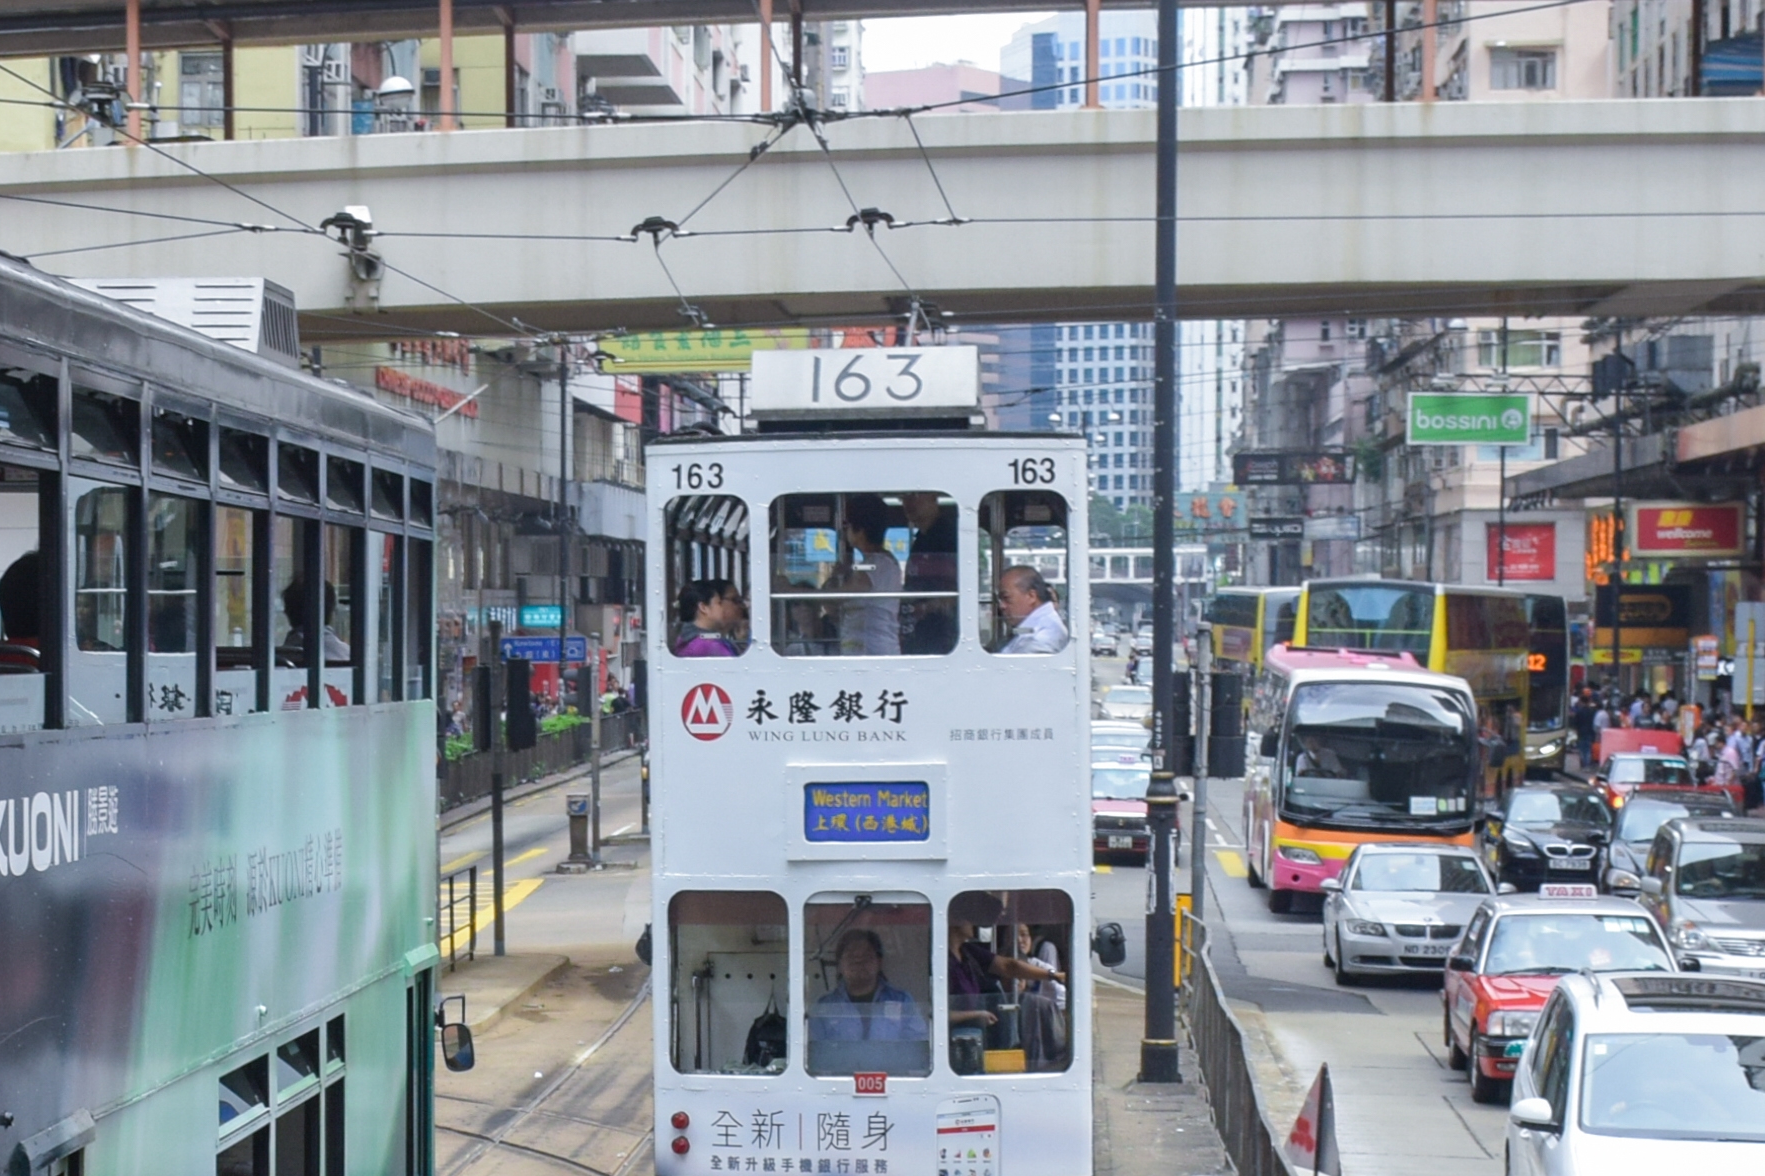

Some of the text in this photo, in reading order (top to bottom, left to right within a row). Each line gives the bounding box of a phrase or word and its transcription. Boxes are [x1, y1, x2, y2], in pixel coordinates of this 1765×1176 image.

[811, 354, 923, 403] 163
[1416, 409, 1497, 430] bossini
[671, 463, 724, 490] 163
[1007, 458, 1056, 485] 163
[745, 689, 909, 725] 永隆銀行
[748, 730, 908, 742] WING LUNG BANK
[812, 789, 928, 808] Western Market
[1546, 886, 1592, 897] TAXI
[1404, 945, 1419, 955] ND
[857, 1077, 883, 1090] 005
[711, 1109, 895, 1151] 全新 隨身
[710, 1155, 889, 1174] 全新升級手機銀行服務
